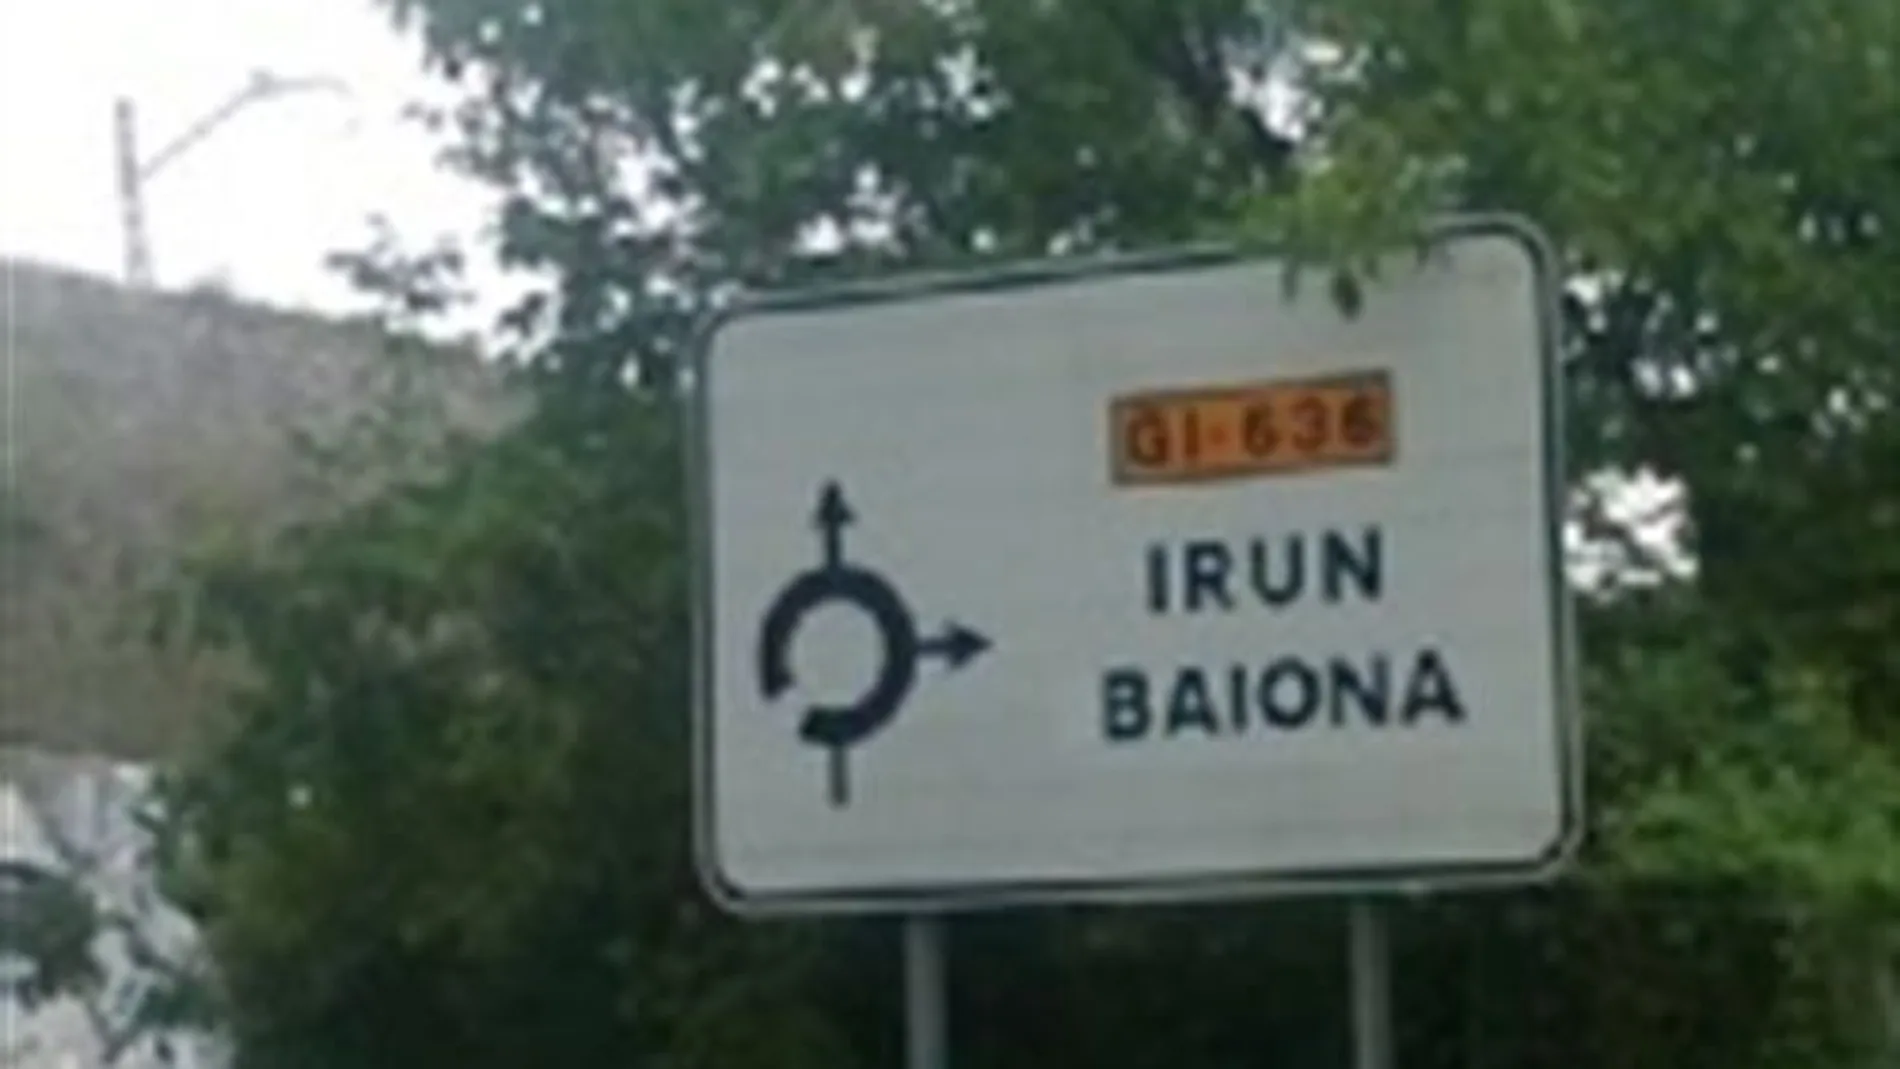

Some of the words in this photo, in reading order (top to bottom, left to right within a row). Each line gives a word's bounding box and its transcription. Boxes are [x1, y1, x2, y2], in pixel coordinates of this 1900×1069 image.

[1125, 395, 1382, 470] GI-636
[1145, 524, 1384, 616] IRUN
[1101, 648, 1468, 744] BAIONA
